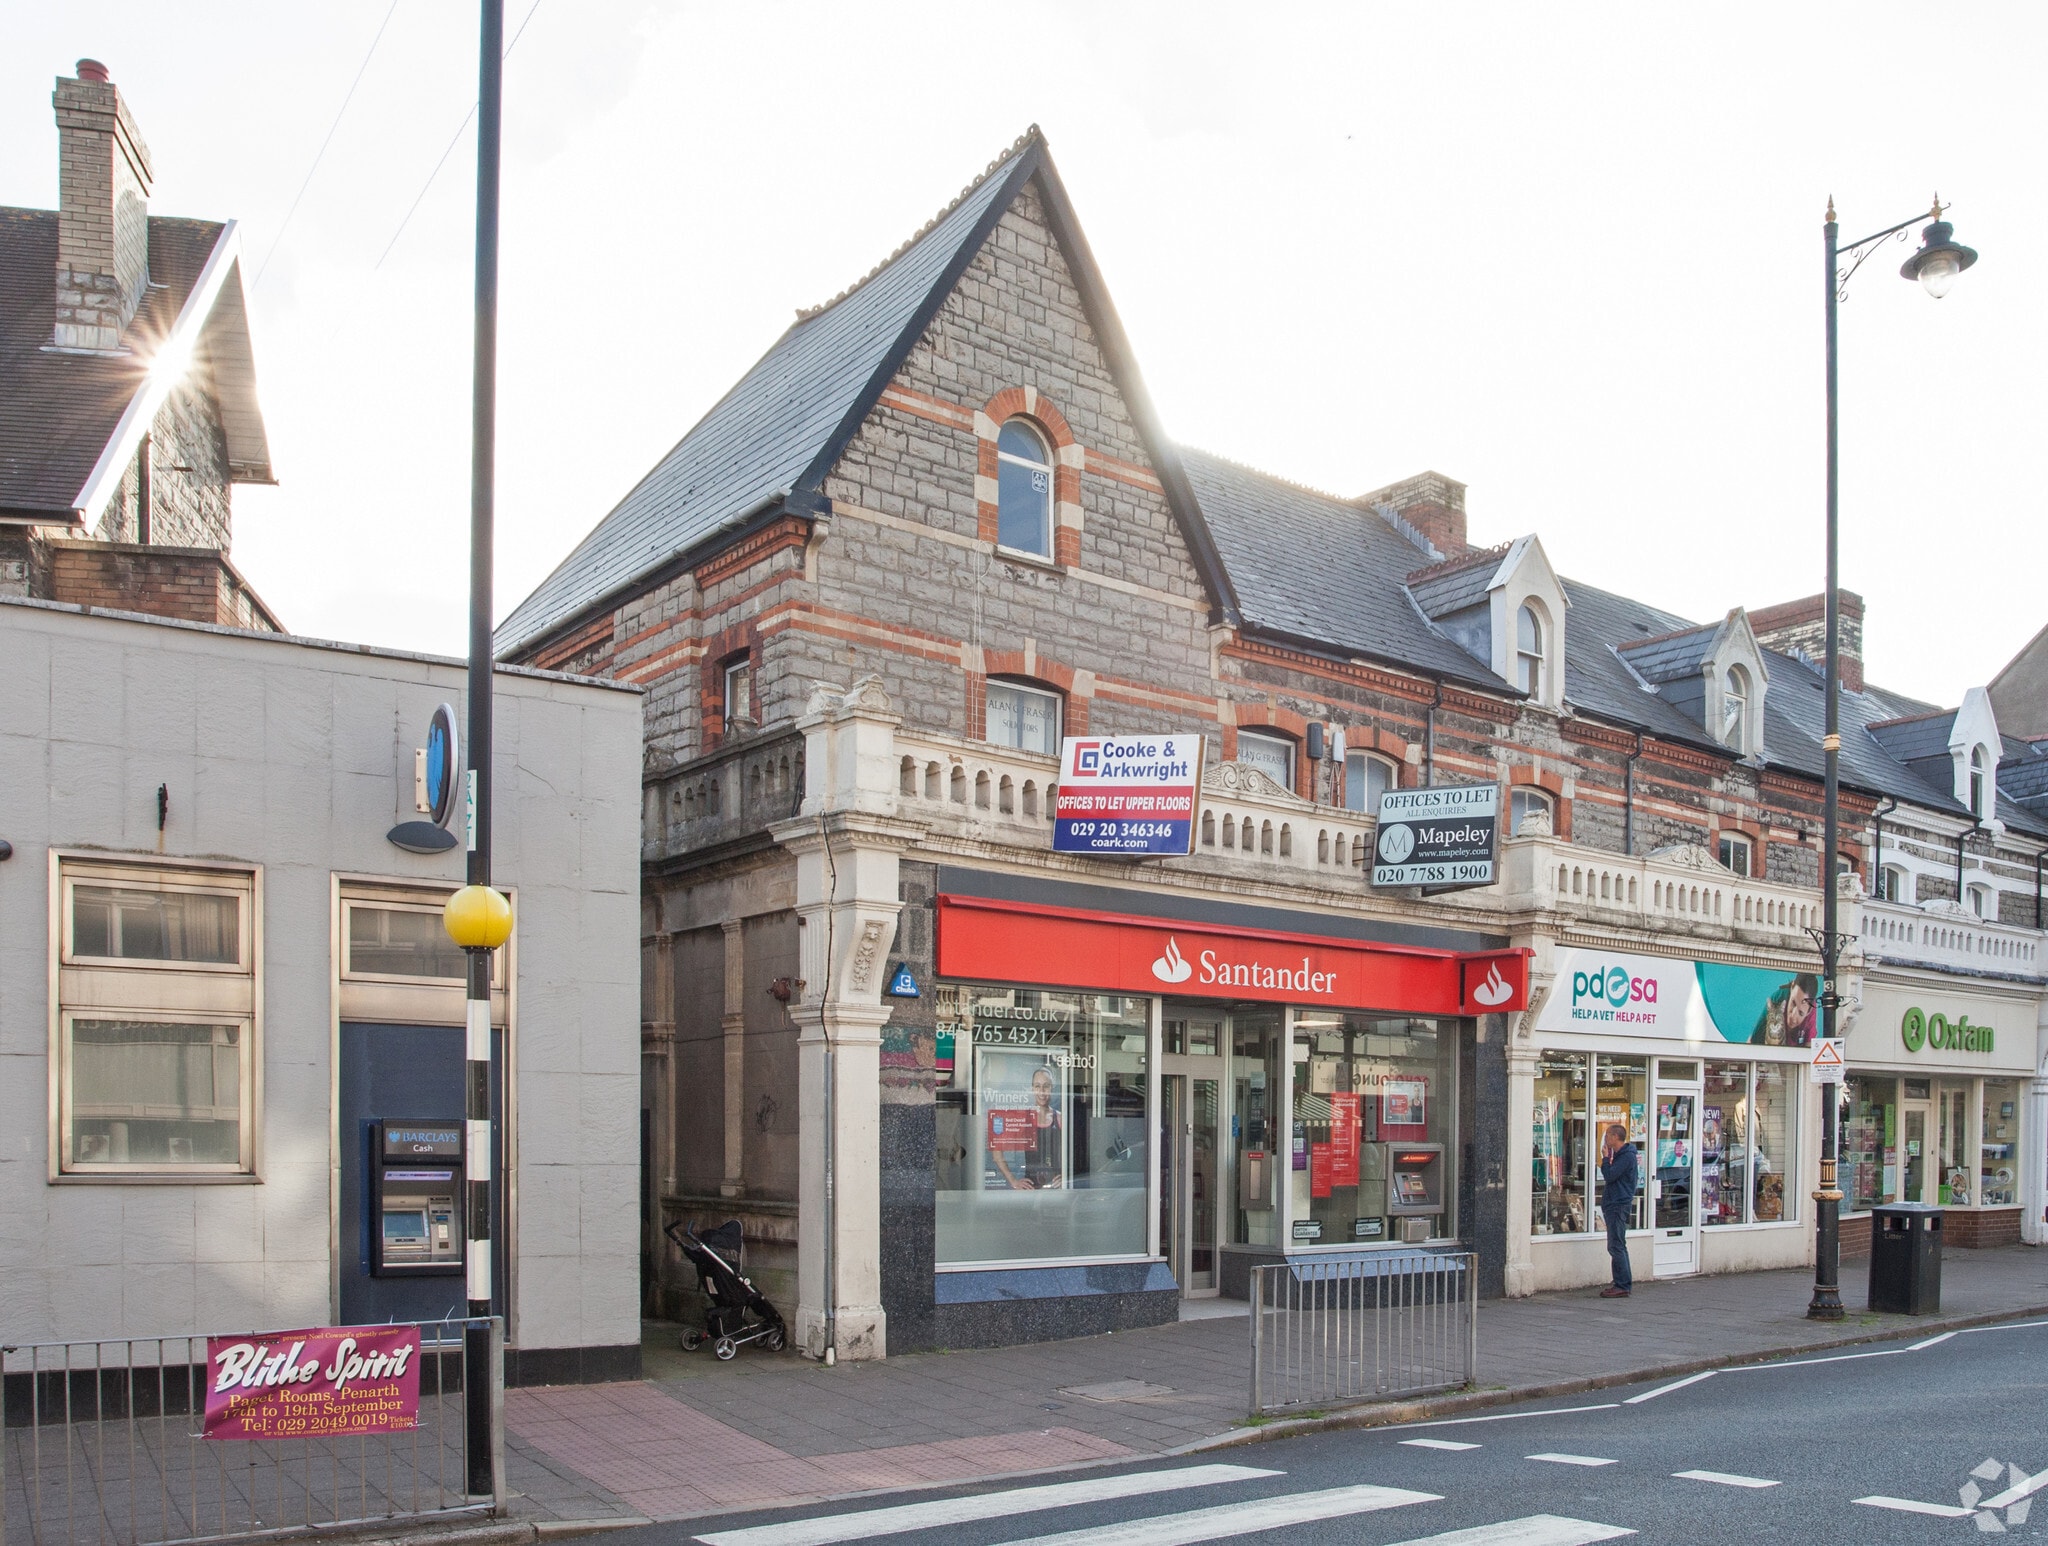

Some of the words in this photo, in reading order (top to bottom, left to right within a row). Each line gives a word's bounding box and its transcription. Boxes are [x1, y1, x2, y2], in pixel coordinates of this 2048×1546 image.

[988, 699, 1011, 711] ALAN
[1002, 719, 1039, 733] SOLITORS
[1103, 741, 1156, 758] Cooke
[1163, 740, 1175, 757] &
[1101, 761, 1188, 781] Arkwright
[1058, 796, 1093, 810] OFFICES
[1095, 796, 1106, 810] TO
[1107, 796, 1124, 810] LET
[1126, 796, 1154, 810] UPPER
[1156, 796, 1191, 811] FLOORS
[1384, 793, 1441, 809] OFFICES
[1444, 792, 1463, 805] TO
[1465, 789, 1493, 803] LET
[1405, 809, 1421, 818] ALL
[1422, 806, 1467, 817] ENQUIRIES
[1070, 822, 1096, 836] 029
[1100, 822, 1117, 836] 20
[1121, 823, 1172, 837] 346346
[1418, 825, 1490, 847] Mapeley
[1091, 837, 1148, 848] coark.com
[1418, 847, 1489, 858] www.mapeley.com
[1377, 868, 1404, 882] 020
[1410, 866, 1445, 881] 7788
[1451, 864, 1487, 880] 1900
[1199, 949, 1337, 993] Santander
[895, 985, 916, 994] Chubb
[1825, 981, 1832, 991] 3
[1572, 1008, 1592, 1019] HELP
[1592, 1009, 1599, 1020] A
[1599, 1010, 1615, 1021] VET
[1616, 1011, 1635, 1023] HELP
[1635, 1013, 1641, 1023] A
[1642, 1013, 1657, 1024] PET
[974, 1024, 1003, 1043] 765
[1008, 1026, 1046, 1045] 4321
[1929, 1012, 1994, 1052] Oxfam
[984, 1089, 1029, 1104] Winners
[402, 1132, 457, 1143] BARCLAYS
[413, 1144, 433, 1153] Cash
[282, 1334, 307, 1342] present
[325, 1331, 355, 1340] Coward's
[214, 1340, 320, 1393] Blithe
[325, 1337, 414, 1391] Spirit
[229, 1393, 274, 1408] Paget
[279, 1389, 335, 1403] Rooms,
[341, 1384, 400, 1400] Penarth
[223, 1406, 256, 1420] 17th
[262, 1404, 278, 1417] to
[284, 1403, 318, 1417] 19th
[323, 1399, 404, 1418] September
[241, 1418, 272, 1432] Tel:
[277, 1417, 306, 1431] 029
[311, 1415, 348, 1429] 2049
[352, 1413, 388, 1427] 0019
